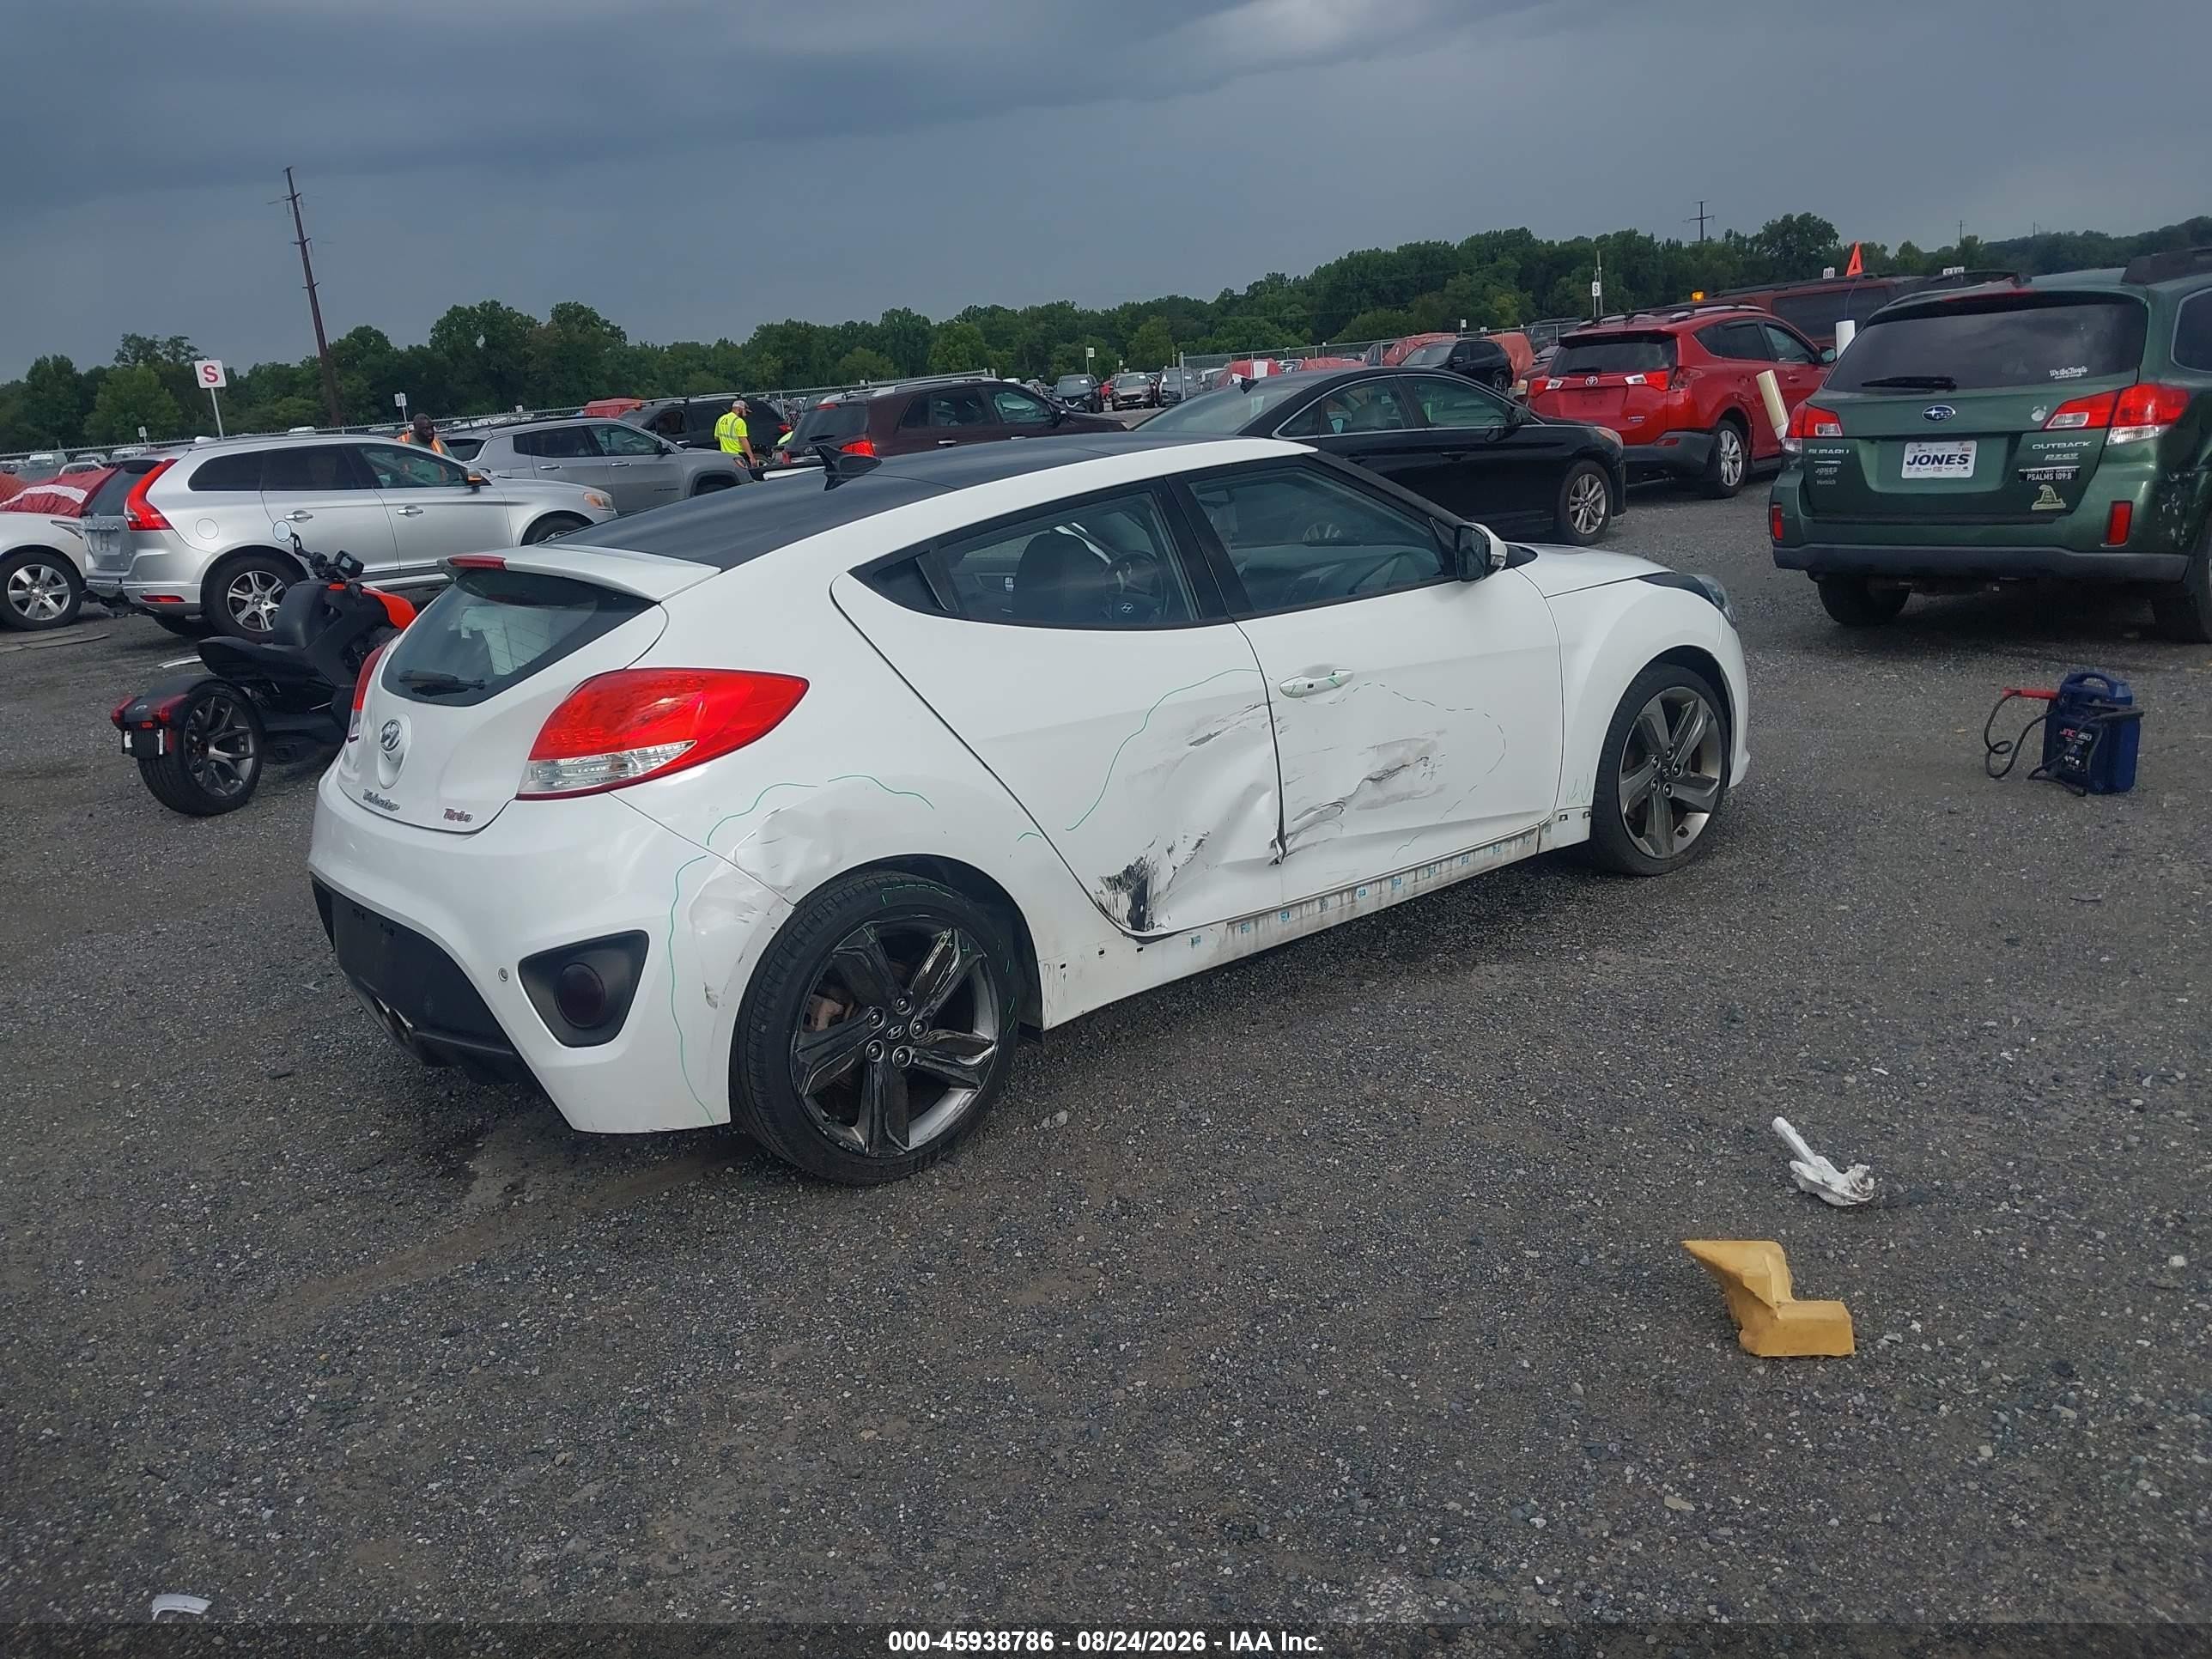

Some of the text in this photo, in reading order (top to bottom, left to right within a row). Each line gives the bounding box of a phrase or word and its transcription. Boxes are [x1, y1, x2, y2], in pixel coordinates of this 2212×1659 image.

[1824, 270, 1833, 278] 80
[203, 365, 219, 383] S
[2032, 441, 2092, 450] OUTBACK
[1906, 453, 1970, 466] JONES
[2027, 472, 2054, 482] PSALMS
[443, 808, 472, 823] Turbo
